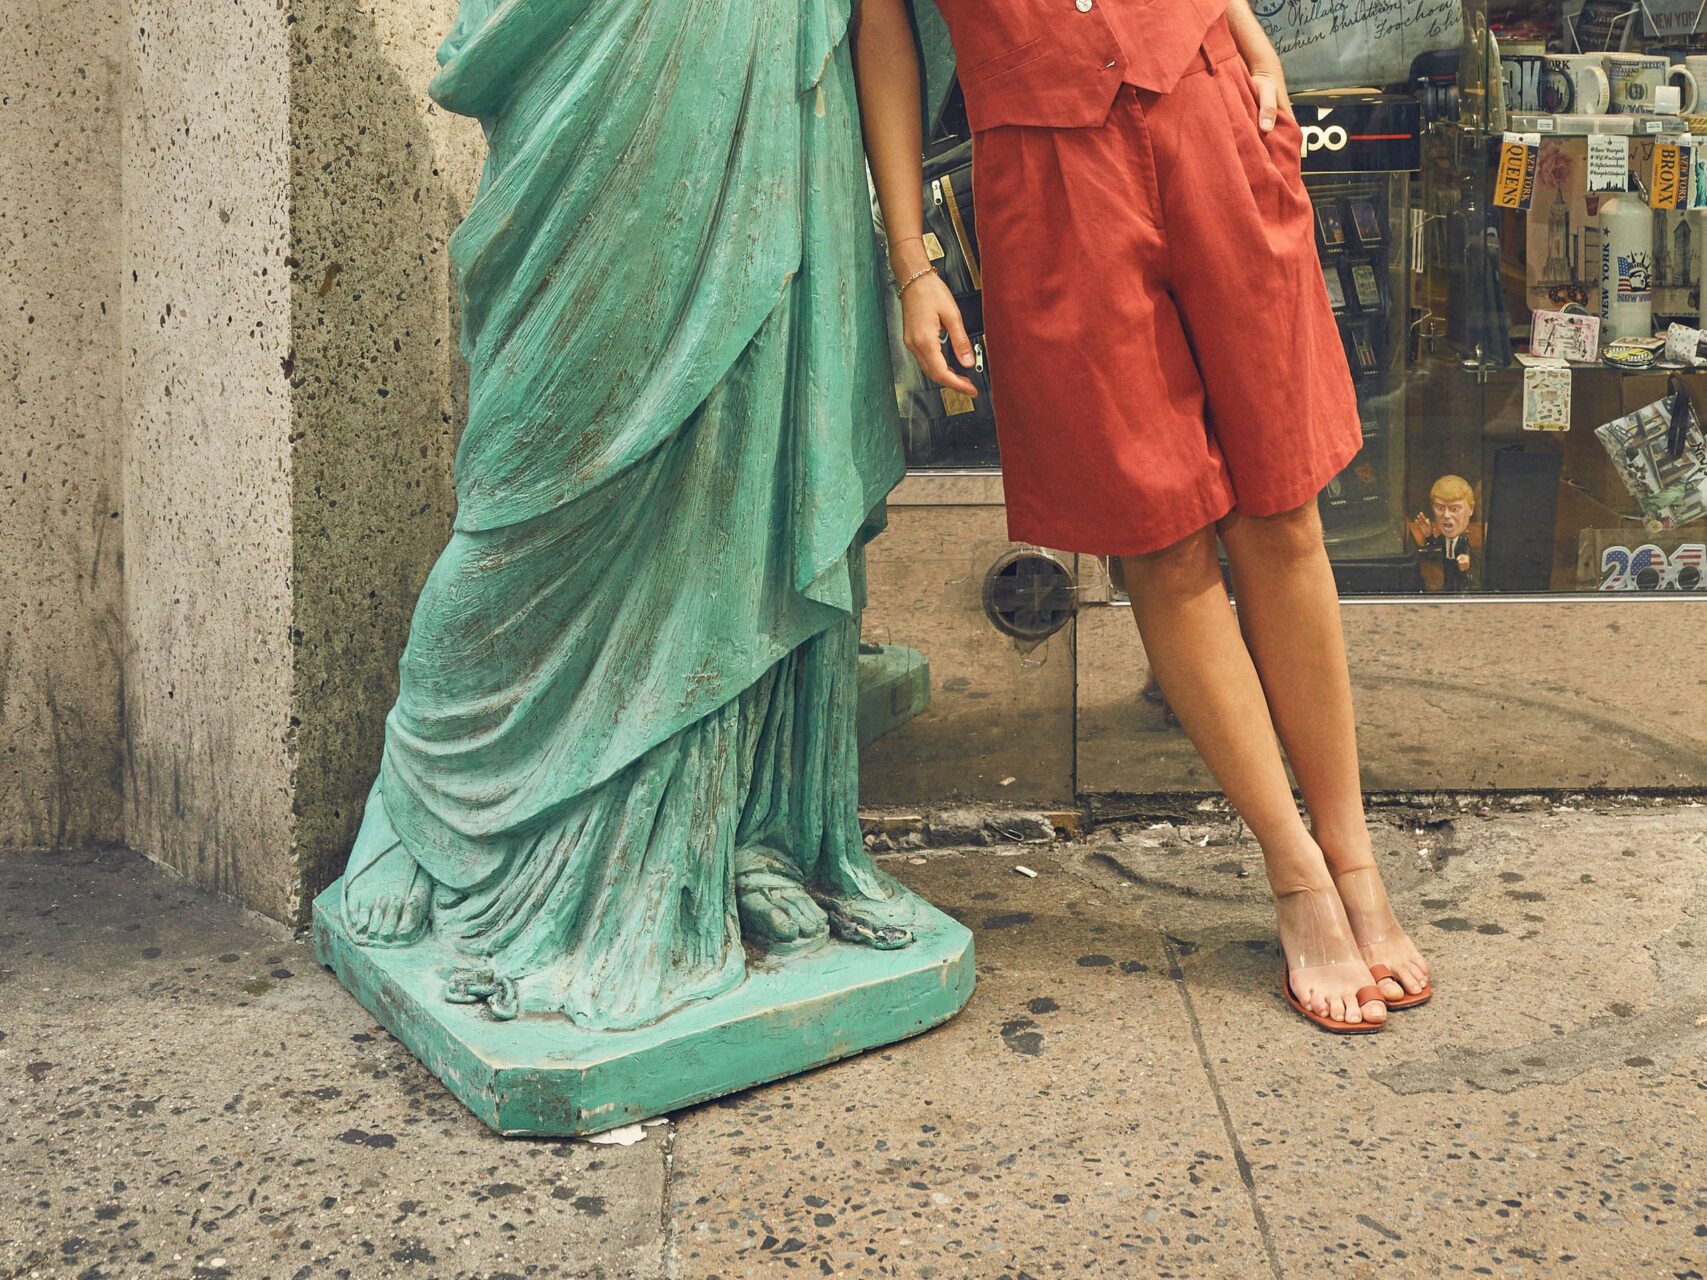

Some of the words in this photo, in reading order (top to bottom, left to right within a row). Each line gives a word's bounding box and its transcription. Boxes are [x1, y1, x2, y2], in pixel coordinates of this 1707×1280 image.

[1548, 60, 1570, 70] ORK
[1300, 125, 1347, 158] po
[1502, 145, 1524, 206] QUEENS
[1527, 152, 1536, 173] NEW
[1658, 149, 1676, 204] BRONX
[1522, 176, 1534, 201] YORK
[1677, 176, 1688, 202] YORK
[1602, 243, 1610, 282] YORK
